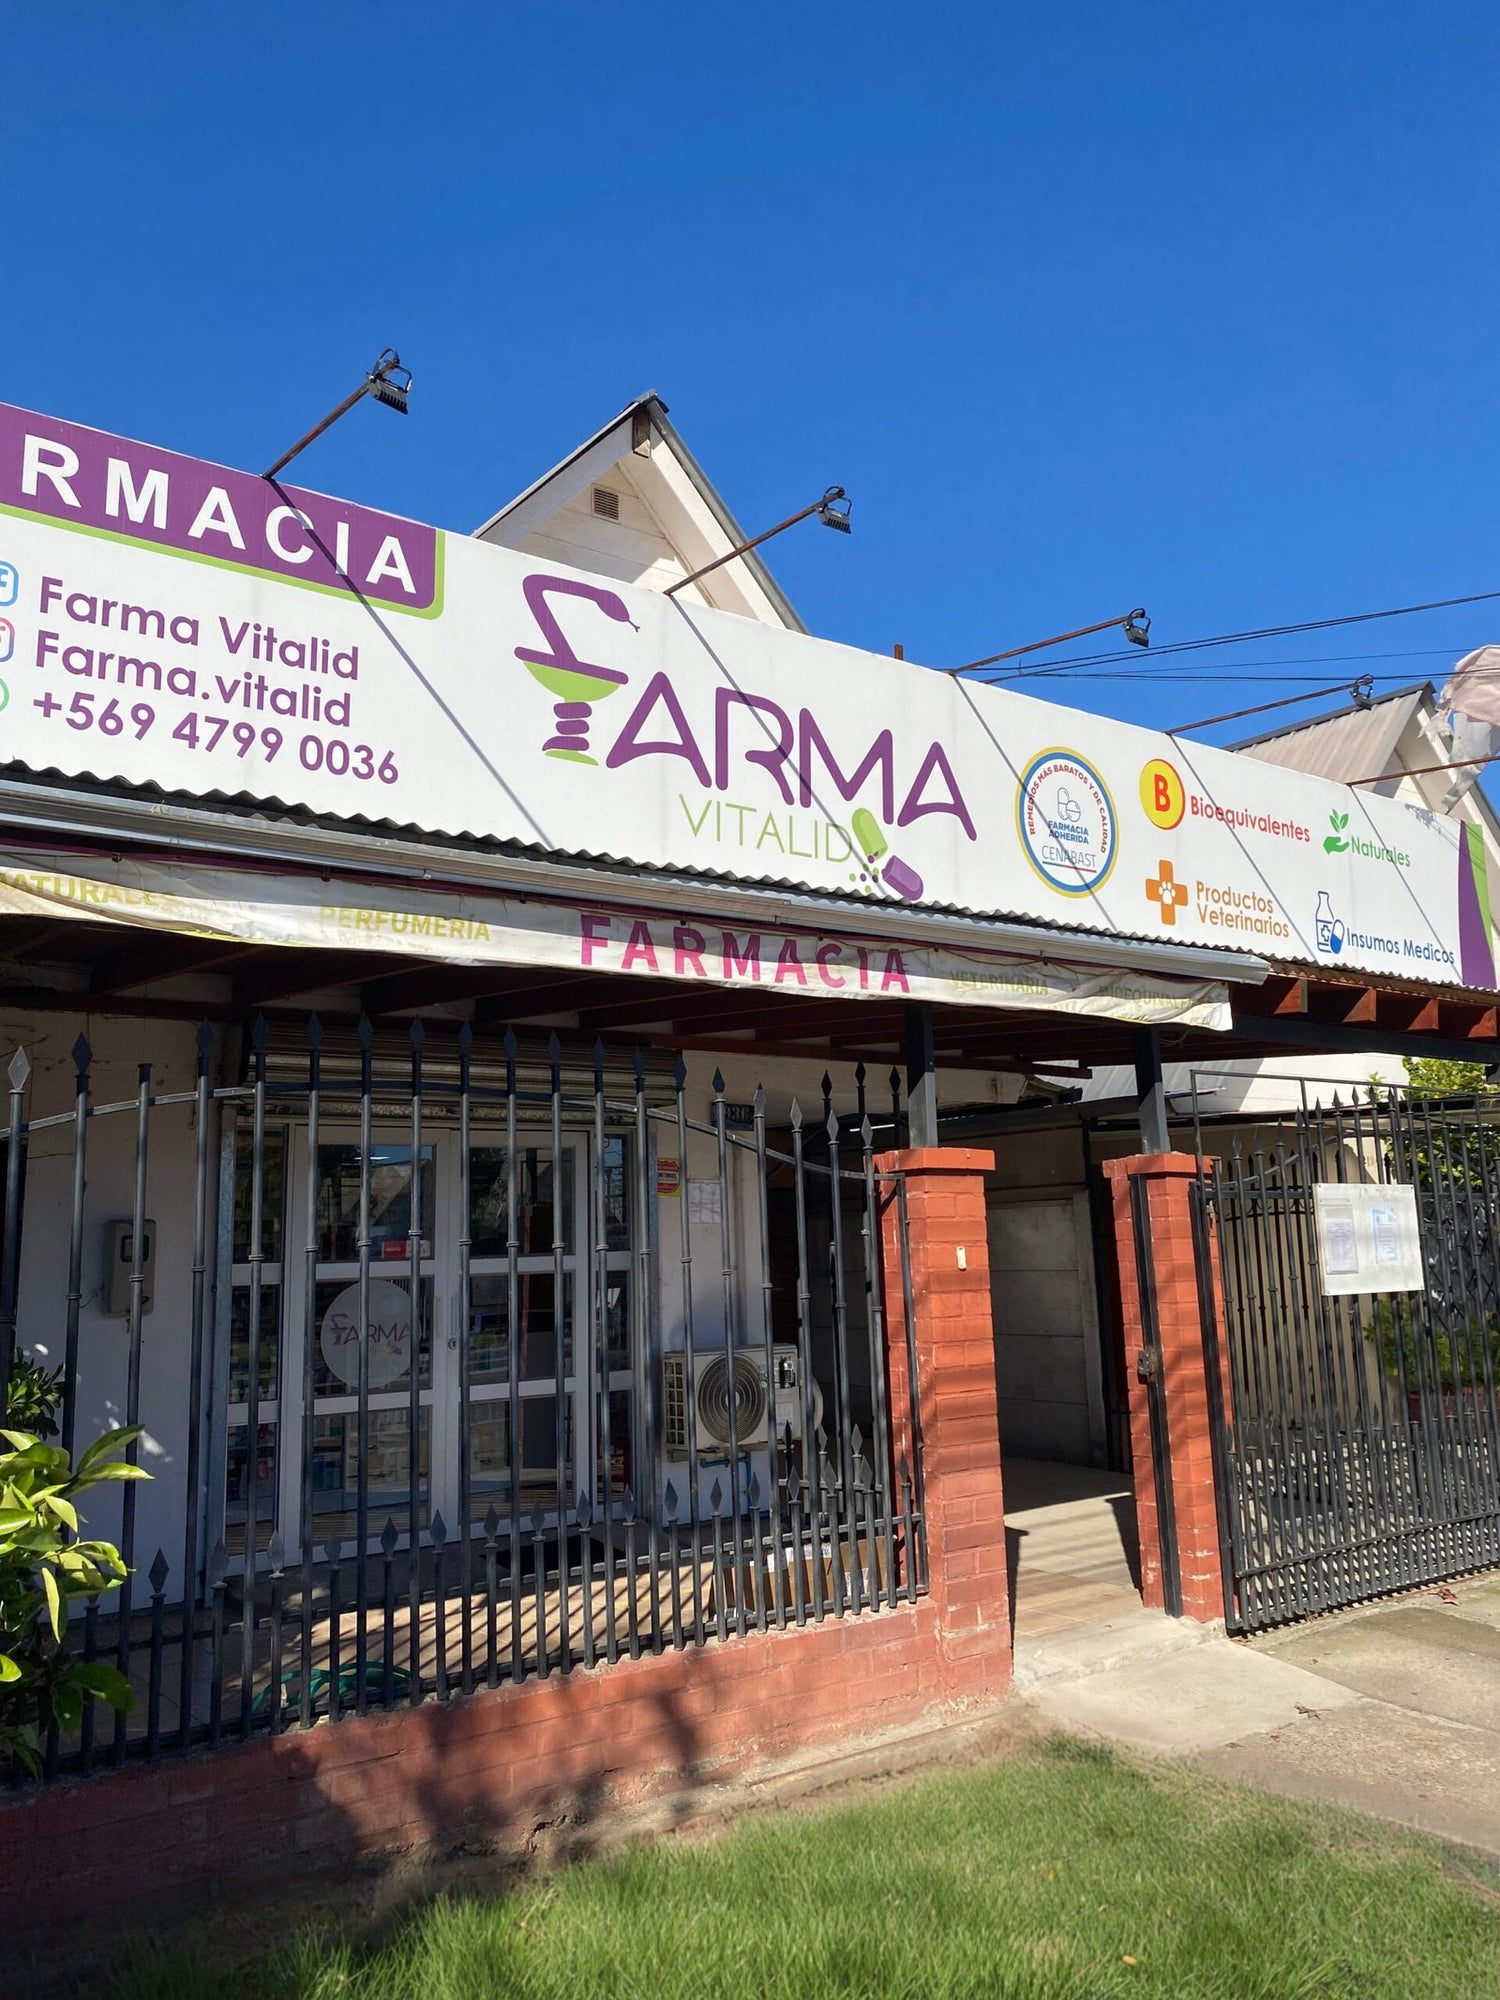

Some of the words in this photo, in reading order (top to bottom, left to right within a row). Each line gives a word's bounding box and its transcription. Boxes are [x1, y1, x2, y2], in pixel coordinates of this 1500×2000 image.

[39, 576, 199, 646] Farma
[219, 616, 359, 681] Vitalid
[35, 630, 351, 728] Farma.vitalid
[33, 691, 155, 741] +569
[172, 712, 283, 763] 4799
[299, 734, 399, 785] 0036
[678, 794, 852, 863] VITALID
[1027, 781, 1040, 835] REMEDIOS
[1053, 764, 1088, 784] BARATOS
[1093, 791, 1102, 806] DE
[1099, 807, 1108, 853] CALIDAD
[1048, 820, 1089, 836] FARMACIA
[1190, 795, 1310, 842] Bioequivalentes
[1041, 845, 1097, 868] CENABAST
[1049, 829, 1089, 844] ADHERIDA
[1351, 836, 1411, 868] Naturales
[1196, 880, 1273, 914] Productos
[1197, 902, 1290, 938] Veterinarios
[581, 914, 910, 993] FARMACIA
[1346, 928, 1399, 954] Insumos
